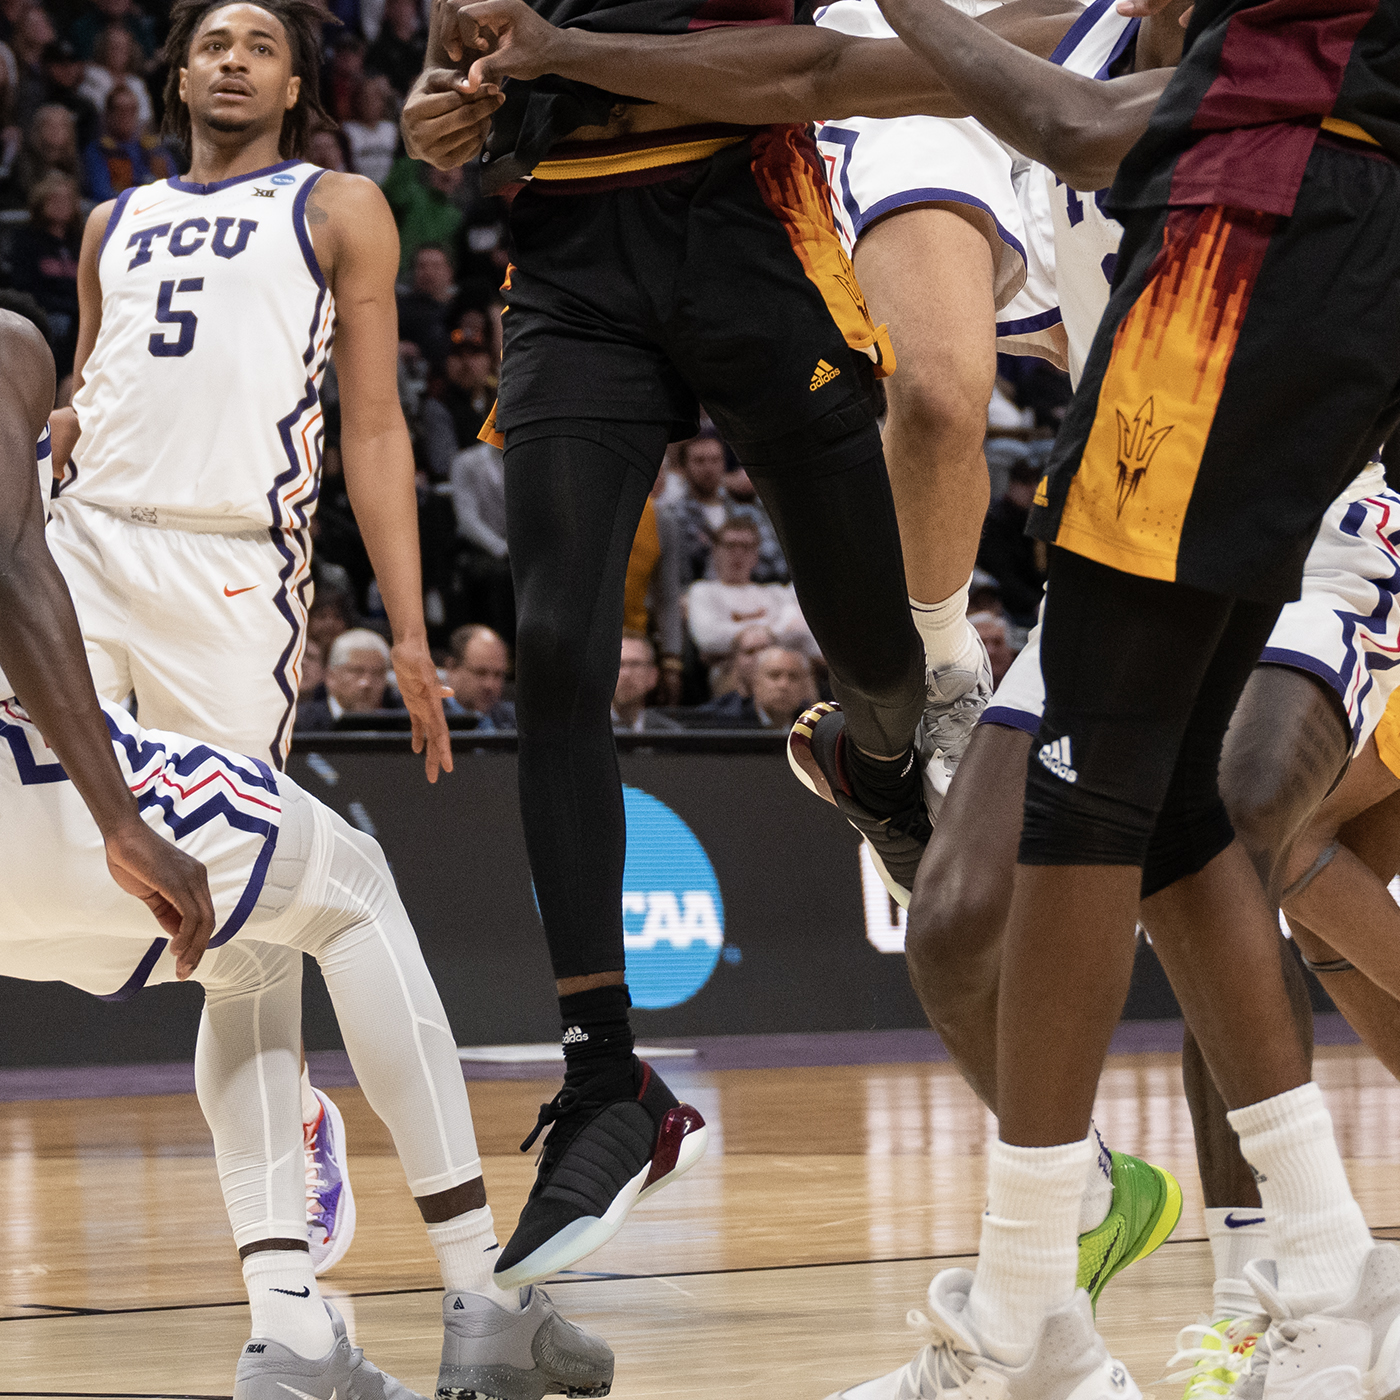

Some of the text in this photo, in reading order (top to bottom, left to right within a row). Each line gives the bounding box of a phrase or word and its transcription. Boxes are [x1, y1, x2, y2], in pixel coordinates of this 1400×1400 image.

[125, 217, 259, 273] TCU
[148, 277, 204, 357] 5
[810, 367, 841, 392] adidas
[622, 891, 725, 948] CAA
[245, 1344, 267, 1353] FREAK
